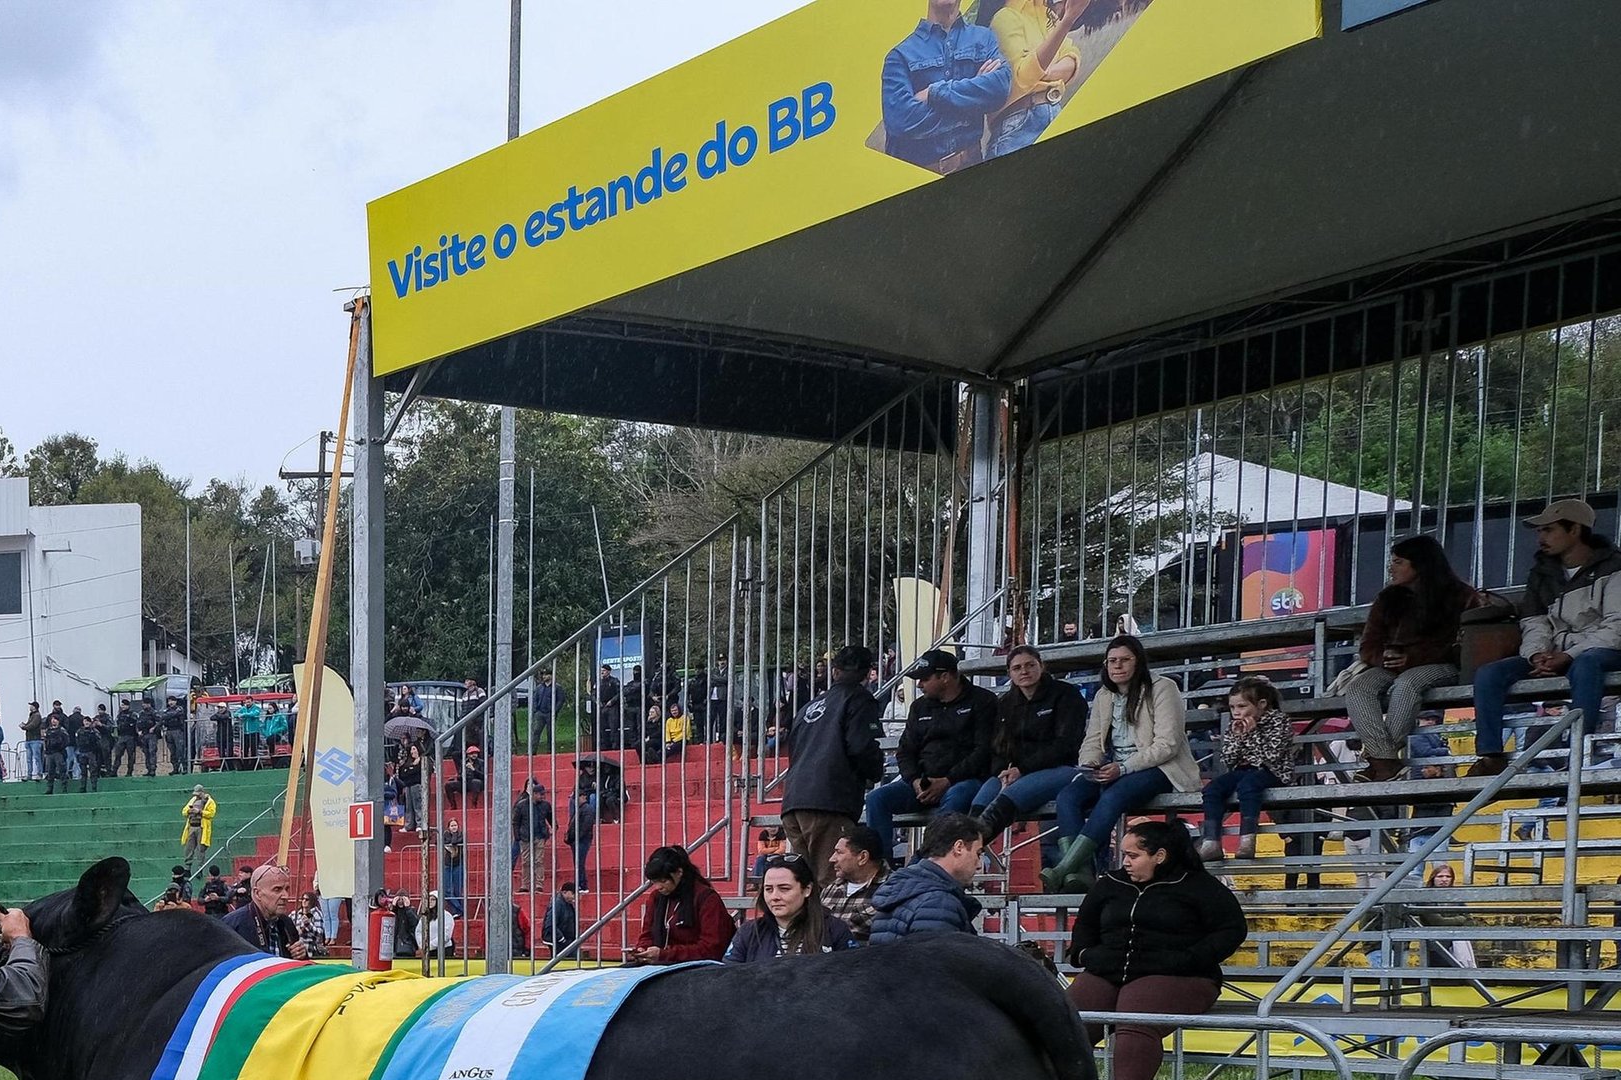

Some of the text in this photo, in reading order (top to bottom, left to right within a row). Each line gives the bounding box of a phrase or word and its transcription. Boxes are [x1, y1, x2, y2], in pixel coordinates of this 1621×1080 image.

[387, 81, 837, 299] Visite o estande do BB
[448, 1066, 494, 1080] ANGUS
